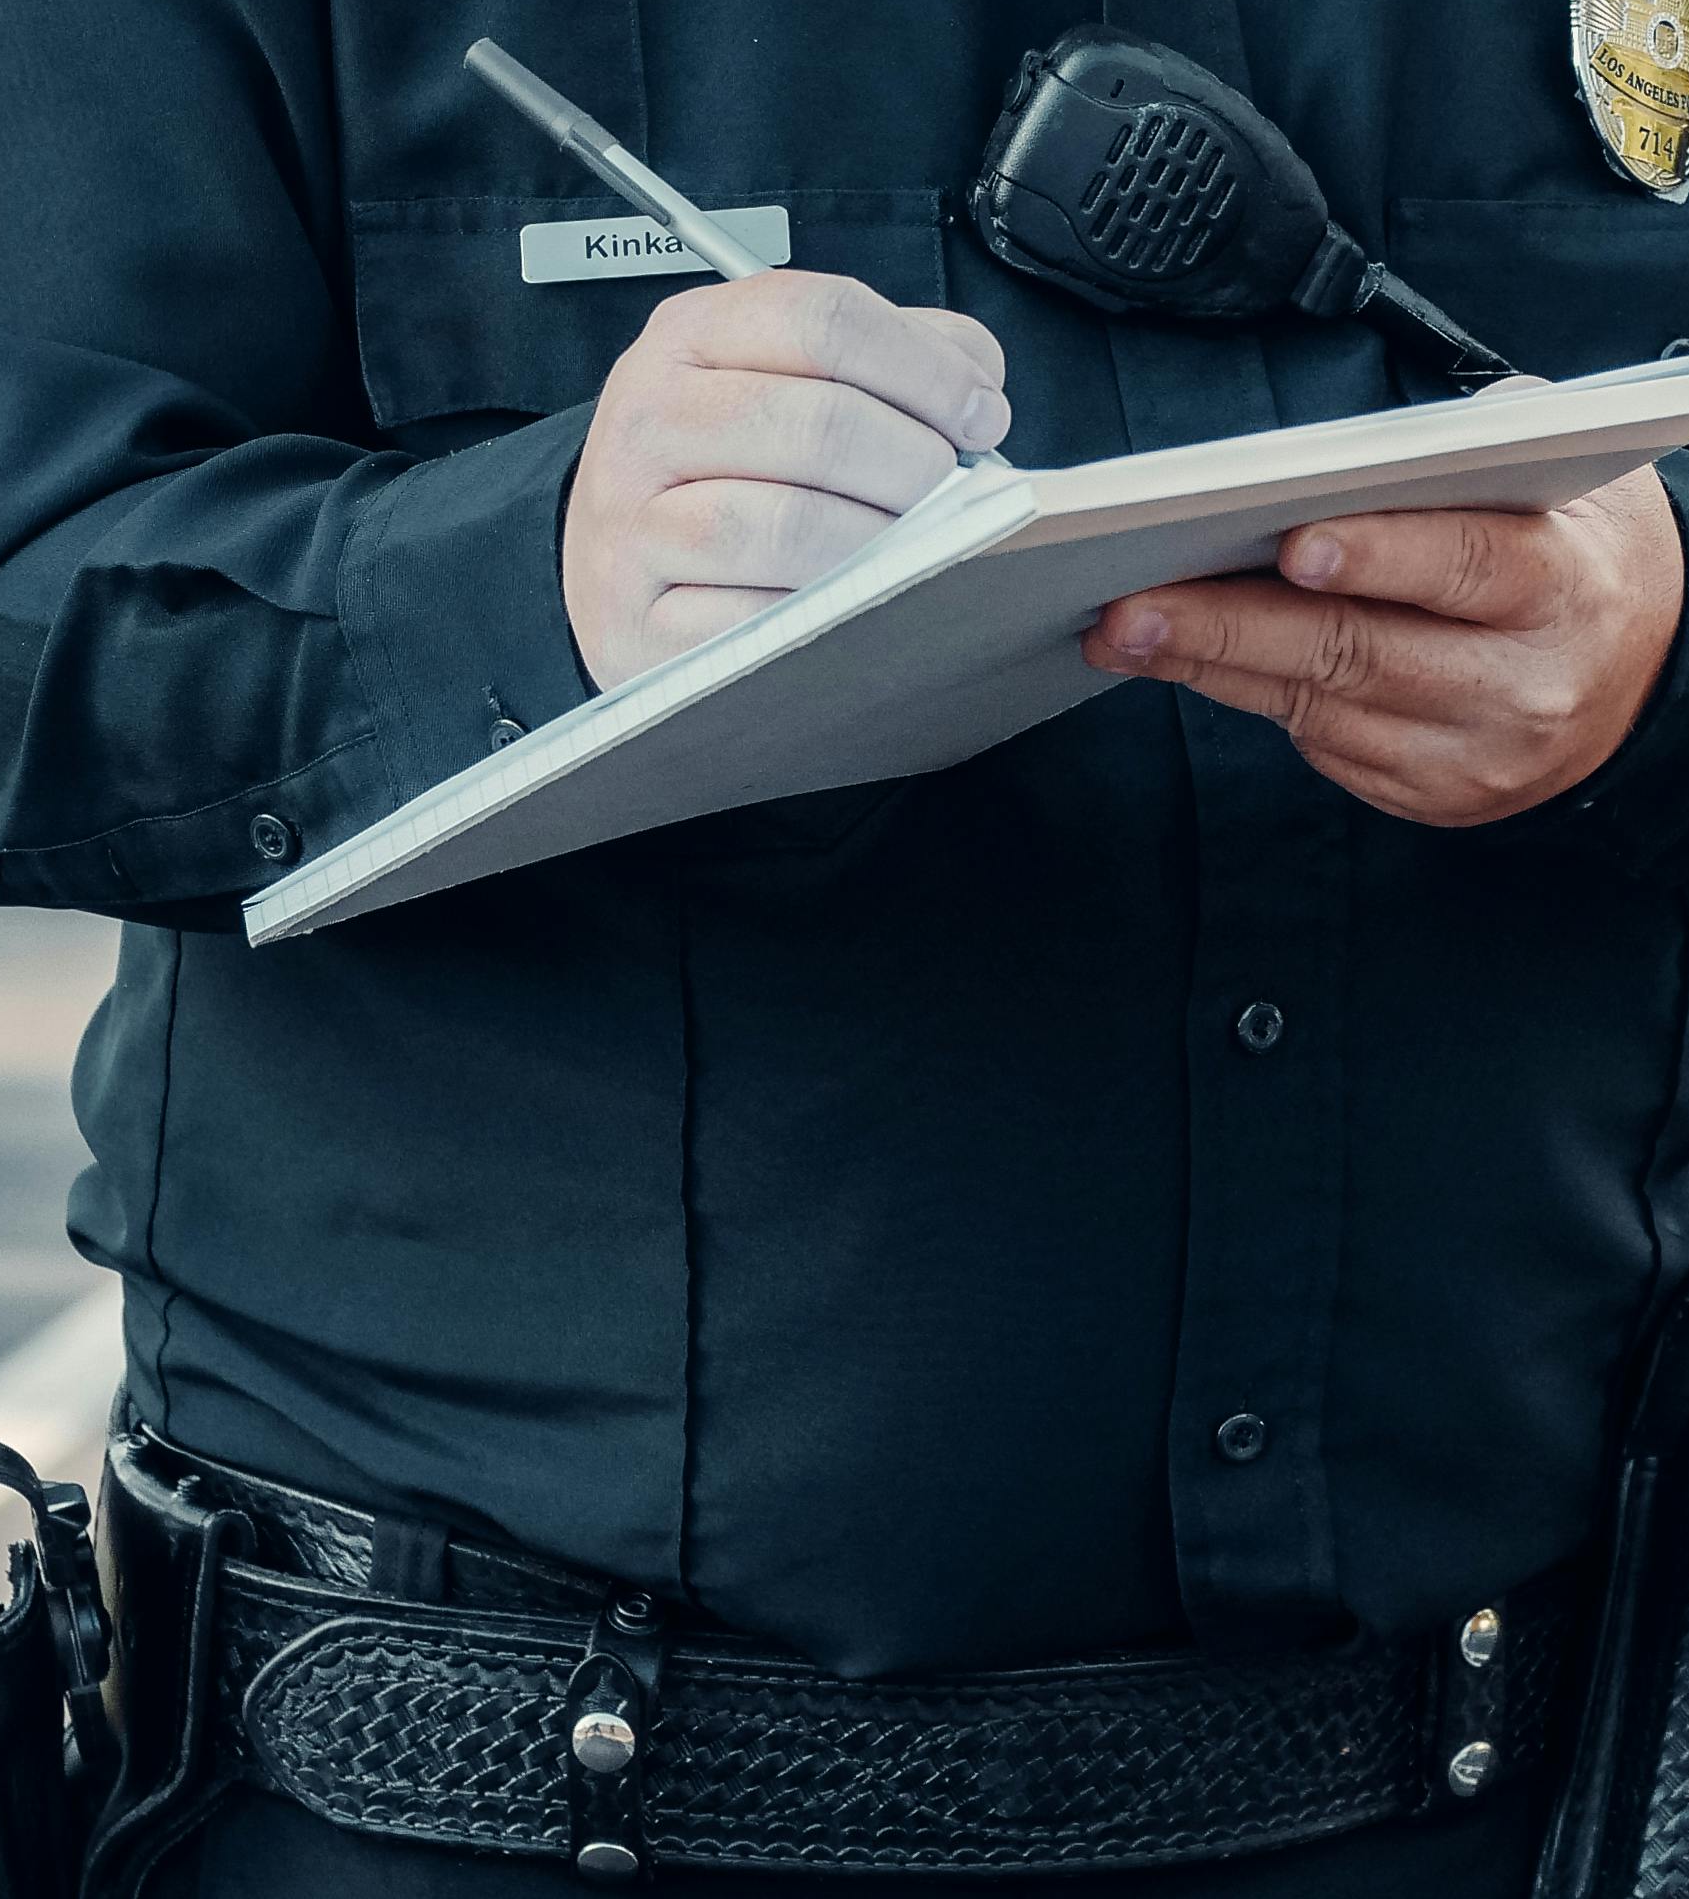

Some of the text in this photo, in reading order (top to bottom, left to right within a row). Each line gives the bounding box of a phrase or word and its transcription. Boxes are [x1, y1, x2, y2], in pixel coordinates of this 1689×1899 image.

[1596, 48, 1625, 78] LOS
[1625, 71, 1679, 108] ANGELES
[1639, 126, 1674, 161] 714
